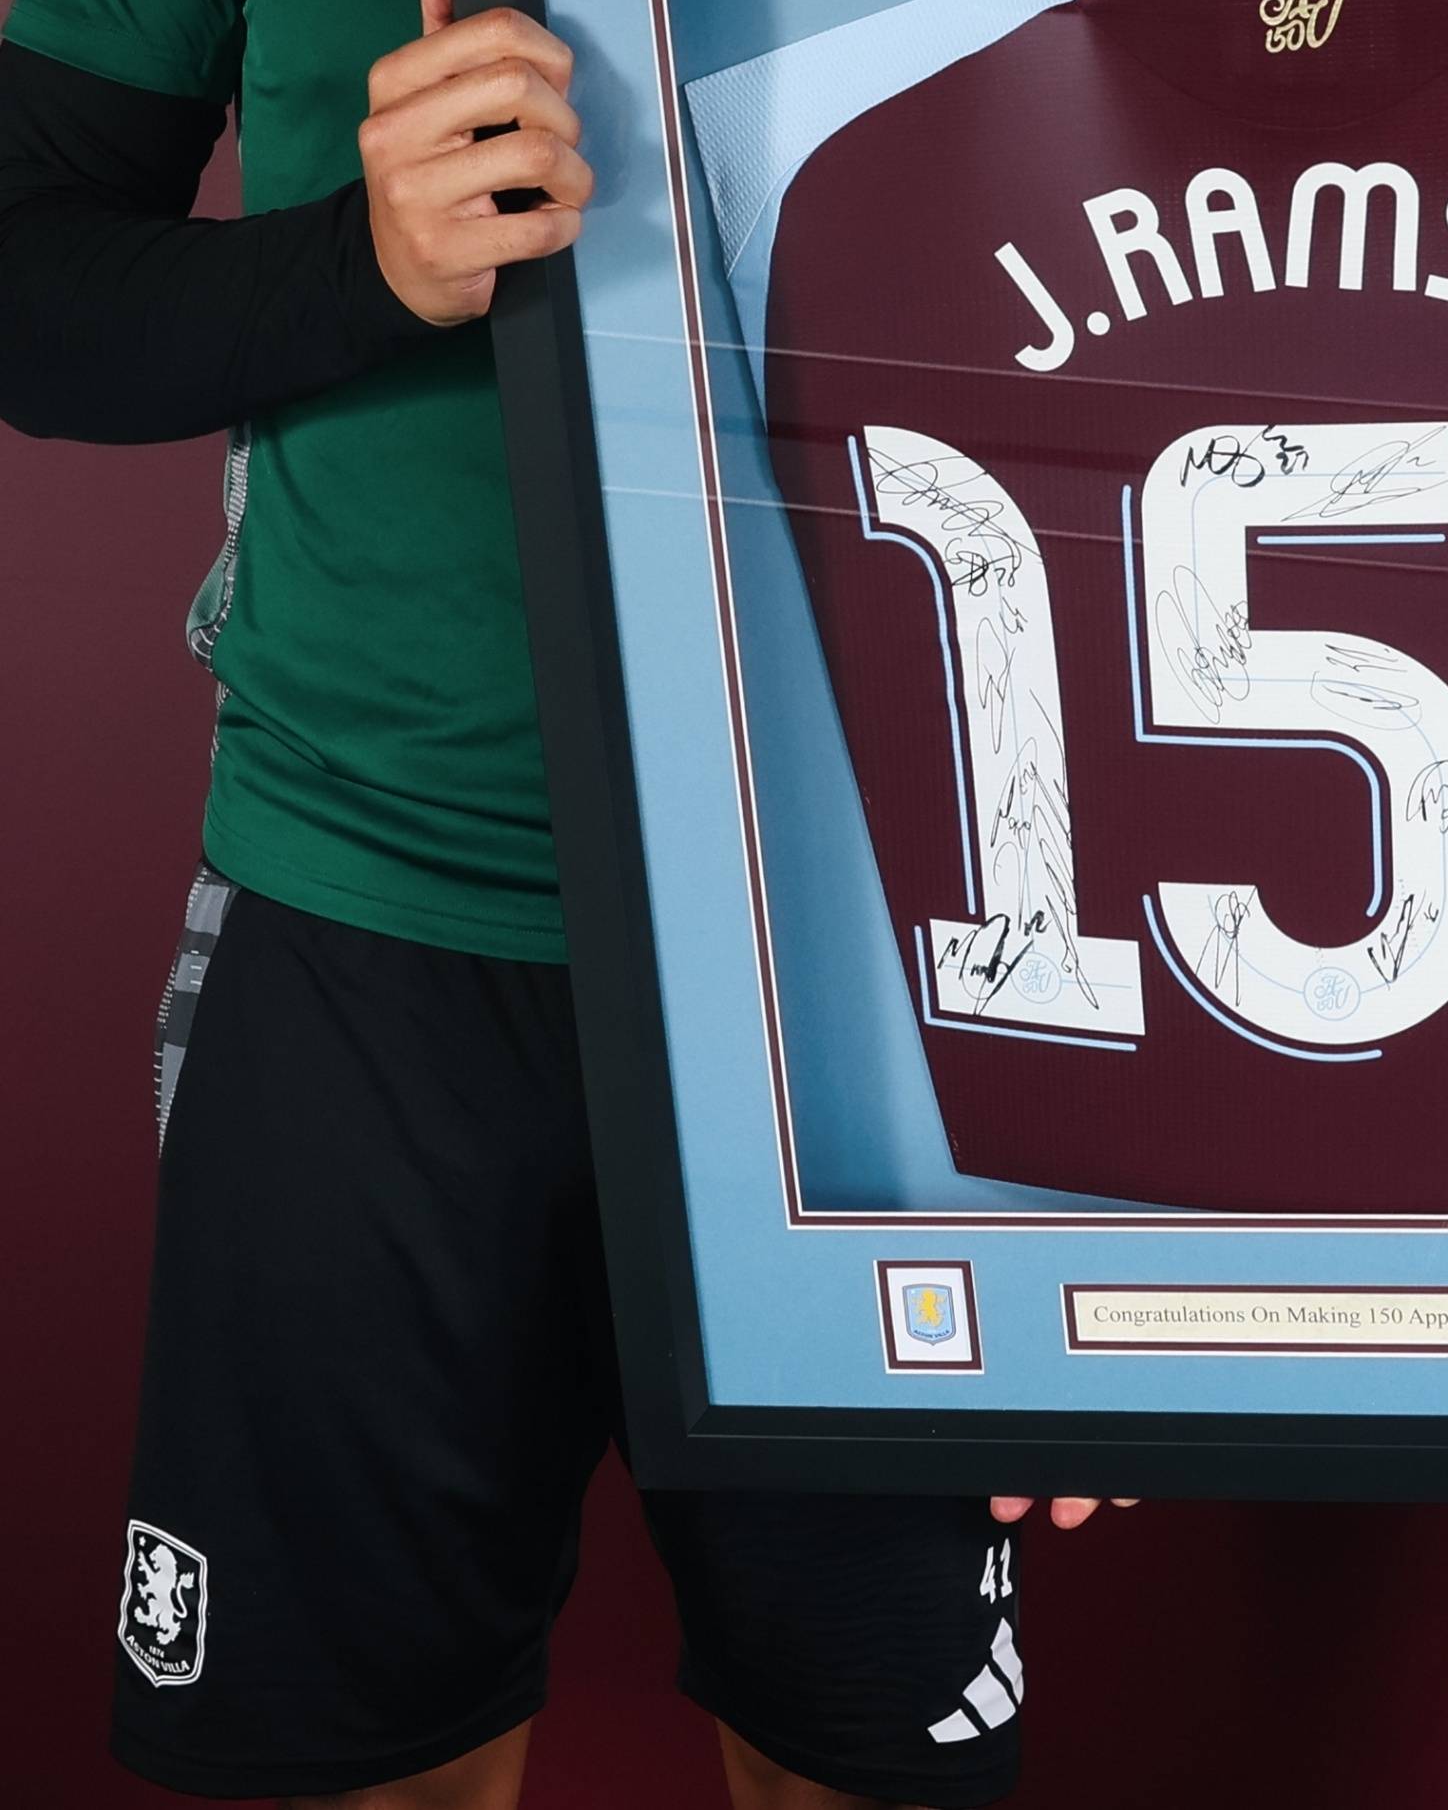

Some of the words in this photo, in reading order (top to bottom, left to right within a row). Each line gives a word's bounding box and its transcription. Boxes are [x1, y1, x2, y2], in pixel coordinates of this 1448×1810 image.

[1093, 1305, 1246, 1327] Congratulations
[1251, 1306, 1281, 1323] On
[1287, 1306, 1362, 1328] Making
[1369, 1308, 1404, 1324] 150
[979, 1538, 1013, 1604] 41
[126, 1634, 160, 1669] ASTON
[160, 1659, 190, 1674] VILLA
